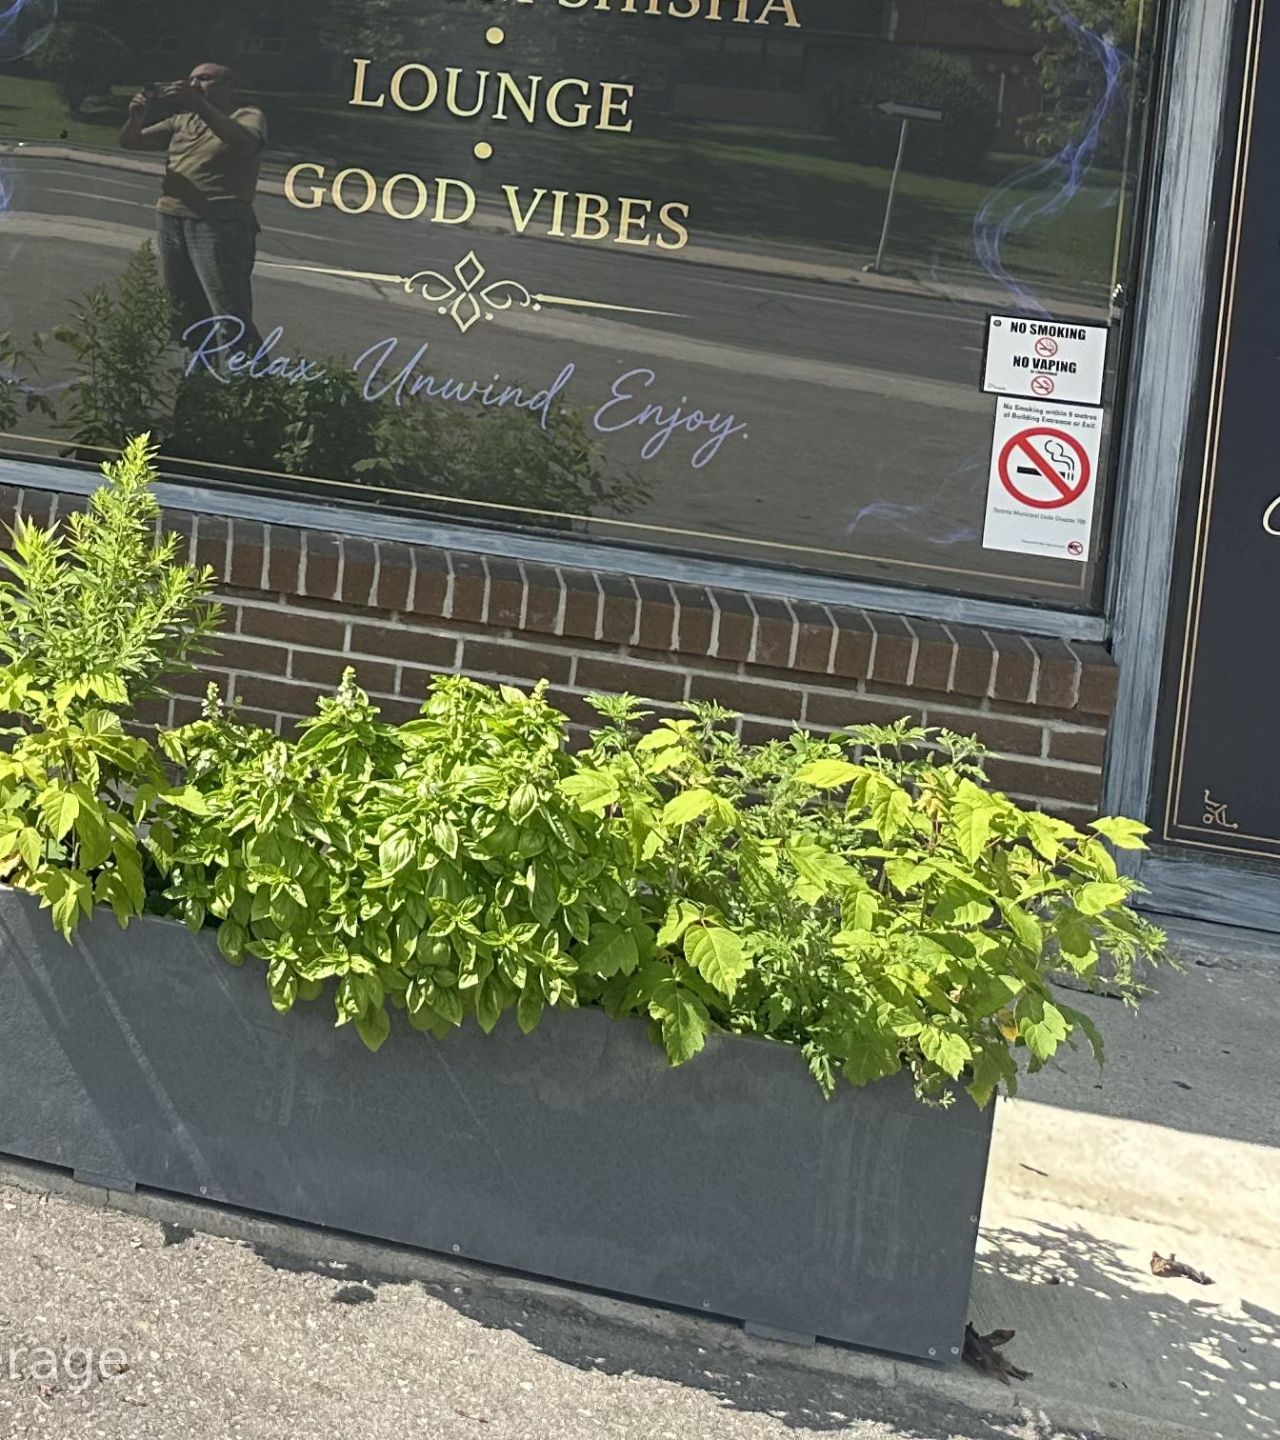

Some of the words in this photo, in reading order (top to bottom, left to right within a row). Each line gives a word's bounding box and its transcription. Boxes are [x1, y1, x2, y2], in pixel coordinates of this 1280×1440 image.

[348, 58, 635, 133] LOUNGE
[283, 162, 477, 225] GOOD
[500, 183, 692, 250] VIBES
[1010, 321, 1028, 334] NO
[1029, 323, 1087, 341] SMOKING
[1012, 355, 1030, 368] NO
[1032, 357, 1078, 374] VAPING
[182, 314, 331, 385] Relax.
[353, 335, 576, 430] Unwind
[593, 367, 750, 469] Enjoy.
[1003, 403, 1013, 411] No
[1014, 404, 1044, 415] Smoking
[1011, 413, 1040, 424] Building
